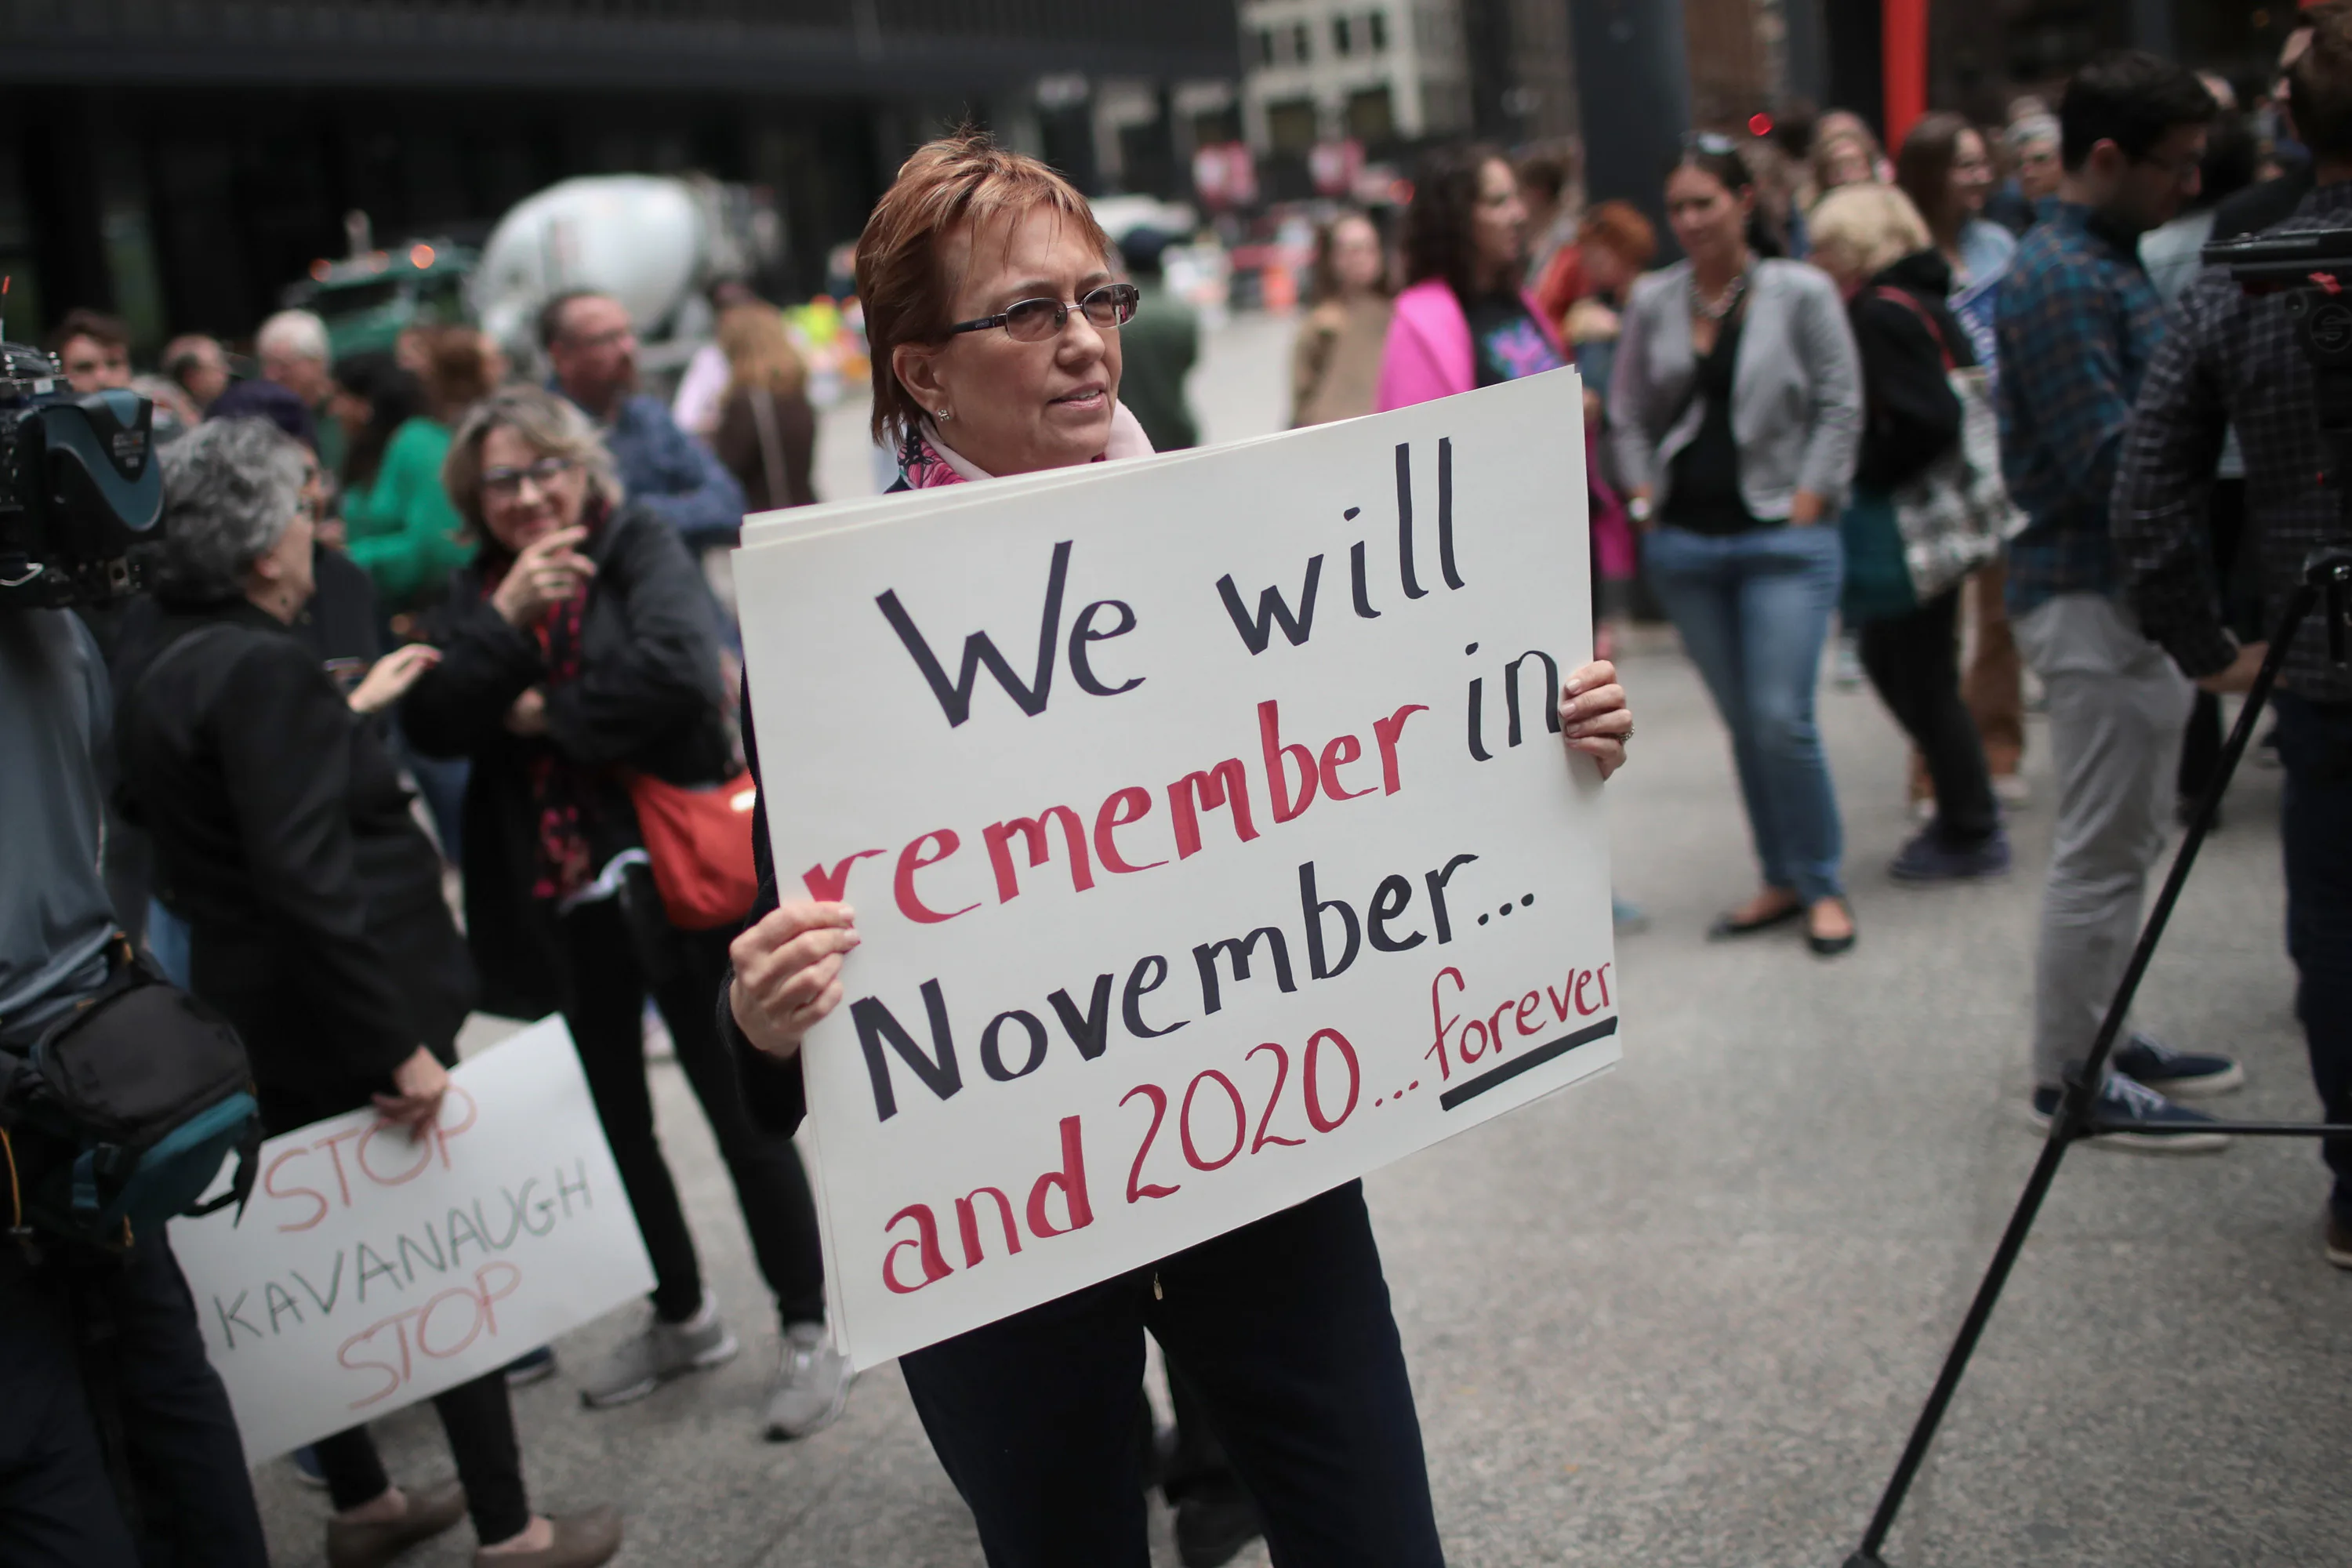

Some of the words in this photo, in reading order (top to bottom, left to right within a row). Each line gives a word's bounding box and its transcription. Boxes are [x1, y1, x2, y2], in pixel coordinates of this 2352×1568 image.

[875, 539, 1146, 728] We
[1215, 436, 1465, 656] will
[802, 699, 1430, 924] remember
[1465, 641, 1562, 762] in
[849, 854, 1535, 1123] November...
[212, 1158, 593, 1349] KAVANAUGH
[263, 1084, 477, 1233] STOP
[882, 1114, 1094, 1294] and
[1424, 961, 1611, 1081] forever
[336, 1260, 523, 1411] STOP
